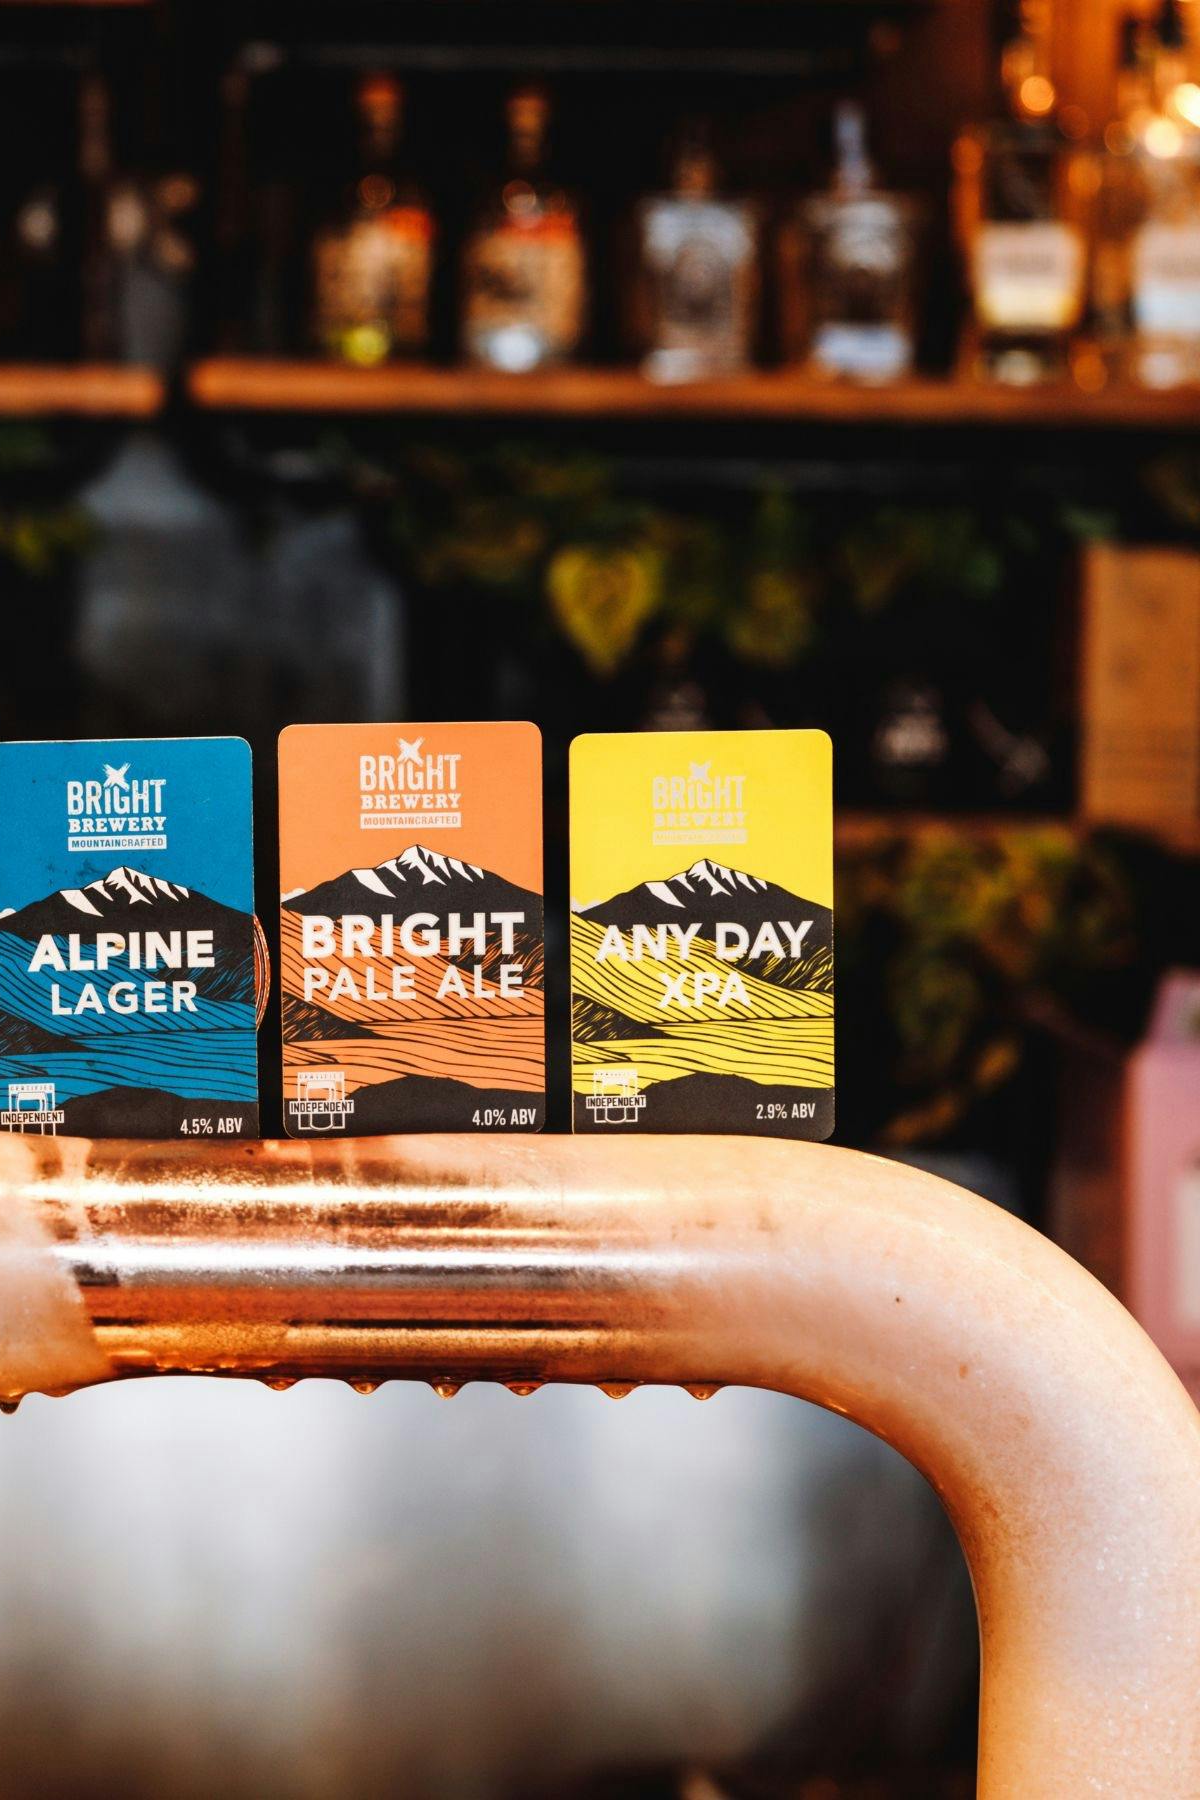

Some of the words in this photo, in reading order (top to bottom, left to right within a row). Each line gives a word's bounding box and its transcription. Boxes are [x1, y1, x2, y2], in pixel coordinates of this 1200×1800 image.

[359, 754, 462, 792] BRIGHT
[66, 779, 167, 816] BRIGHT
[360, 792, 462, 810] BREWERY
[652, 775, 747, 810] BRIGHT
[67, 816, 167, 834] BREWERY
[363, 815, 459, 827] MOUNTAINCRAFTED
[653, 810, 748, 828] BREWERY
[70, 837, 164, 849] MOUNTAINCRAFTED
[302, 911, 525, 960] BRIGHT
[593, 922, 703, 964] ANY
[715, 920, 815, 960] DAY
[27, 930, 216, 973] ALPINE
[303, 965, 417, 1003] PALE
[434, 963, 525, 1000] ALE
[658, 971, 752, 1009] XPA
[51, 980, 199, 1016] LAGER
[290, 1101, 354, 1113] INDEPENDENT
[586, 1096, 647, 1108] INDEPENDENT
[755, 1103, 788, 1120] 2.9%
[791, 1102, 816, 1119] ABV
[2, 1111, 65, 1124] INDEPENDENT
[180, 1118, 214, 1135] 4.5%
[217, 1117, 243, 1133] ABV
[471, 1109, 507, 1126] 4.0%
[510, 1108, 537, 1125] ABV
